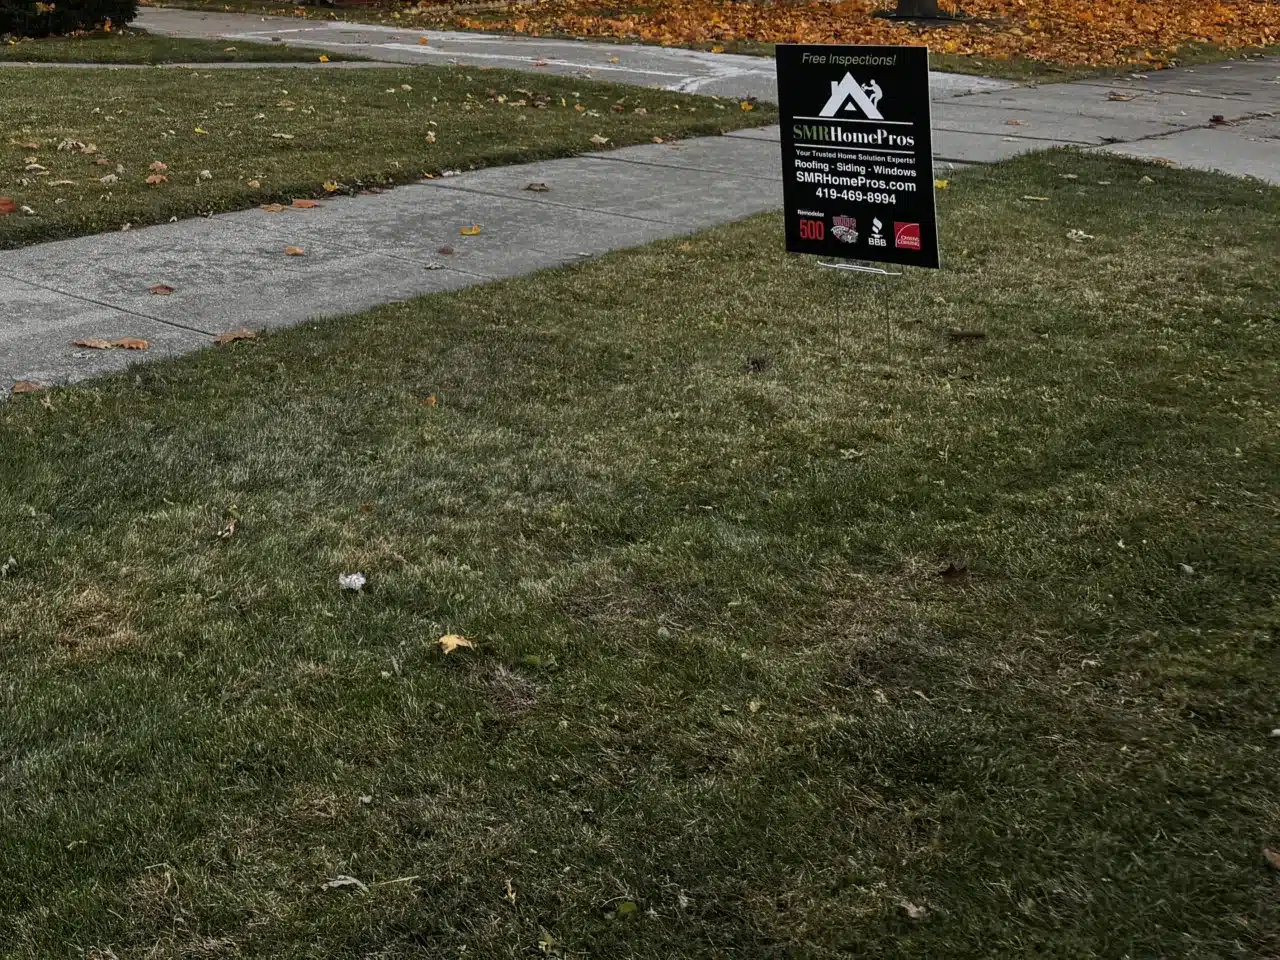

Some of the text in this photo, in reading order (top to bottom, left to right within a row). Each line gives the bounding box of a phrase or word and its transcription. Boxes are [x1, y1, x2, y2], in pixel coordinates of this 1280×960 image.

[802, 52, 897, 67] Free Inspections!
[796, 149, 811, 157] Your
[812, 150, 836, 159] Trusted
[838, 152, 857, 160] Home
[858, 154, 886, 162] Solution
[794, 159, 829, 171] Roofing
[836, 162, 866, 174] Siding
[873, 165, 917, 177] Windows
[796, 171, 917, 192] SMRHomePros.com
[815, 187, 896, 205] 419-469-8994
[800, 218, 825, 241] 500
[868, 237, 887, 247] BBB
